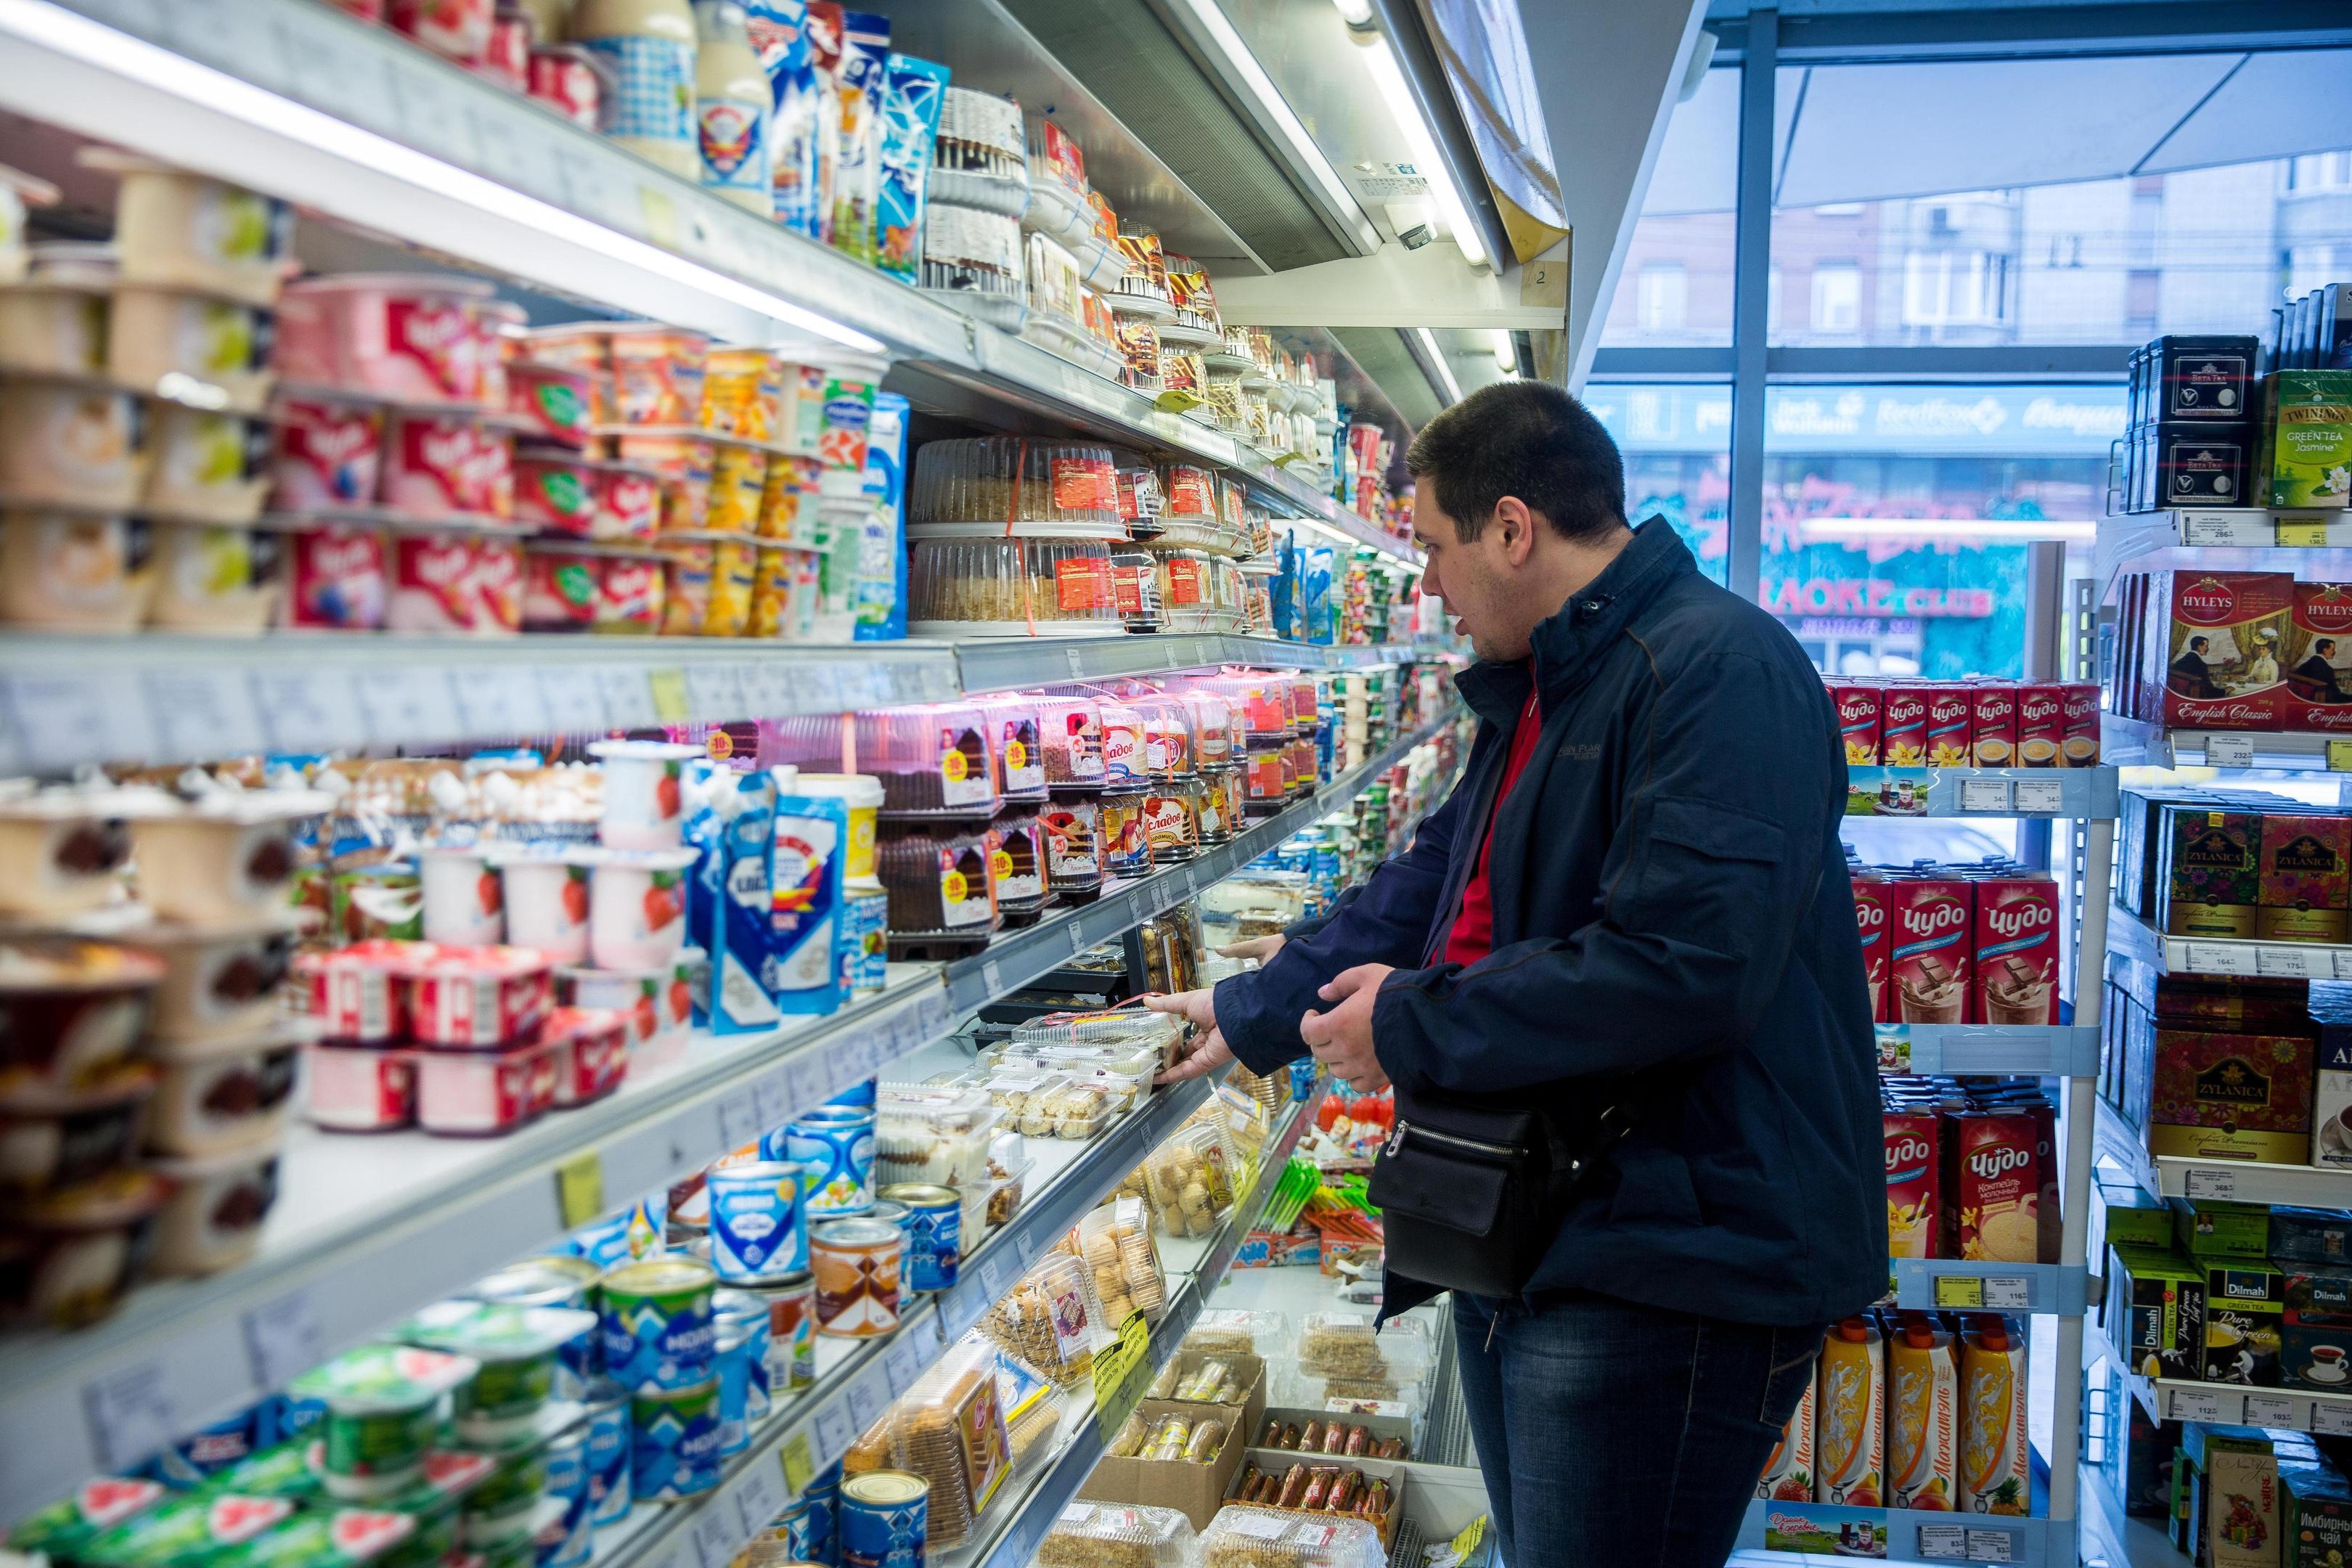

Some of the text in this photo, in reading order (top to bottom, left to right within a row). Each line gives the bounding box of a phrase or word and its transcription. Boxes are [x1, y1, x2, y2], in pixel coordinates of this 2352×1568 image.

[1535, 270, 1545, 285] 2
[2284, 407, 2347, 422] TWININGS
[2287, 432, 2343, 444] GREEN TEA
[2295, 444, 2335, 452] Jasmine
[2183, 596, 2232, 608] HYLEYS
[2178, 701, 2273, 723] English Classic
[1147, 812, 1181, 830] сладов
[1151, 832, 1175, 844] ирамису
[2189, 852, 2242, 862] ZYLANICA
[2279, 856, 2332, 867] ZYLANICA
[2199, 1084, 2264, 1097] ZYLANICA
[1885, 1138, 1930, 1170] удо
[1970, 1147, 2030, 1180] Чудо
[1977, 1179, 2021, 1193] Коктейль
[1980, 1186, 2020, 1199] молочный
[2228, 1283, 2265, 1297] Dilmah
[2314, 1290, 2346, 1302] Dilmah
[2178, 1289, 2194, 1342] Pure Green
[2219, 1311, 2253, 1326] Pure
[2144, 1309, 2158, 1346] Dilmah
[2231, 1324, 2271, 1344] Green
[1933, 1387, 1953, 1482] Мажитэль
[2012, 1388, 2028, 1483] Мажитэль
[2300, 1512, 2352, 1531] Имбирны
[2319, 1532, 2340, 1545] чай
